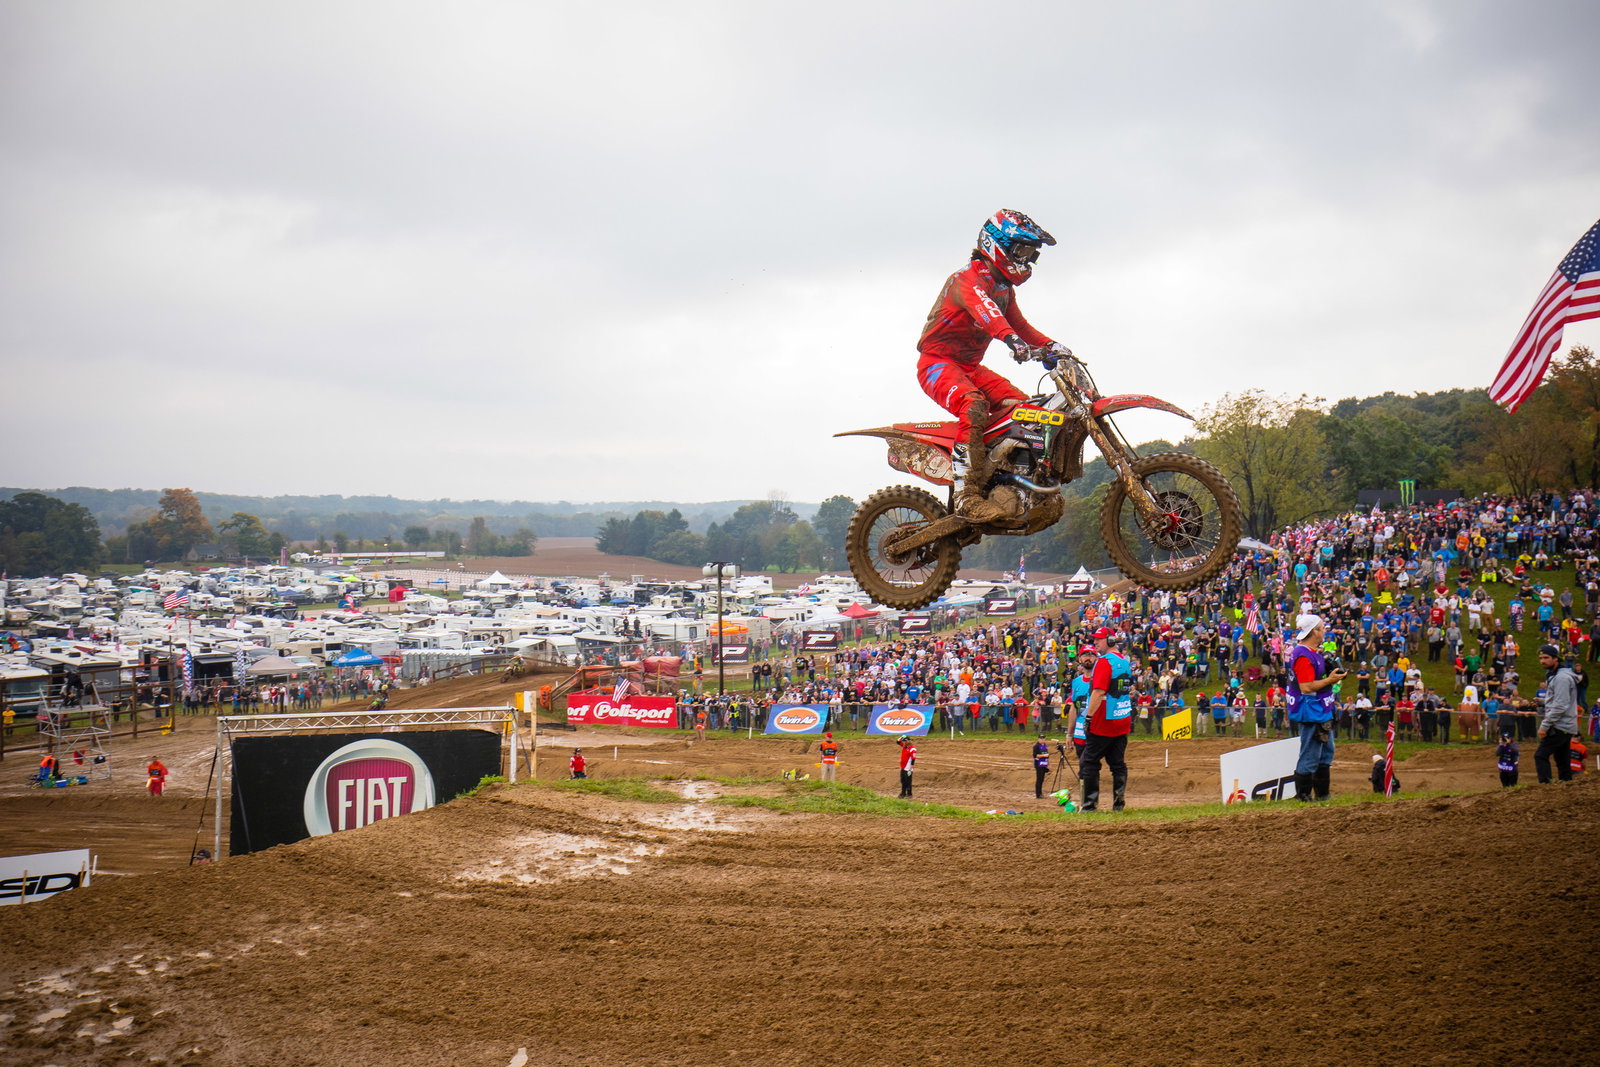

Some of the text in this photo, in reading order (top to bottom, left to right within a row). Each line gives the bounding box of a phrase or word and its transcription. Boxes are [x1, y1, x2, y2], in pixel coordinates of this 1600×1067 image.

[1012, 408, 1065, 426] GEICO
[597, 704, 674, 720] Polisport
[779, 716, 817, 725] Twin Air
[881, 716, 921, 726] Twin Air
[338, 776, 408, 831] FIAT
